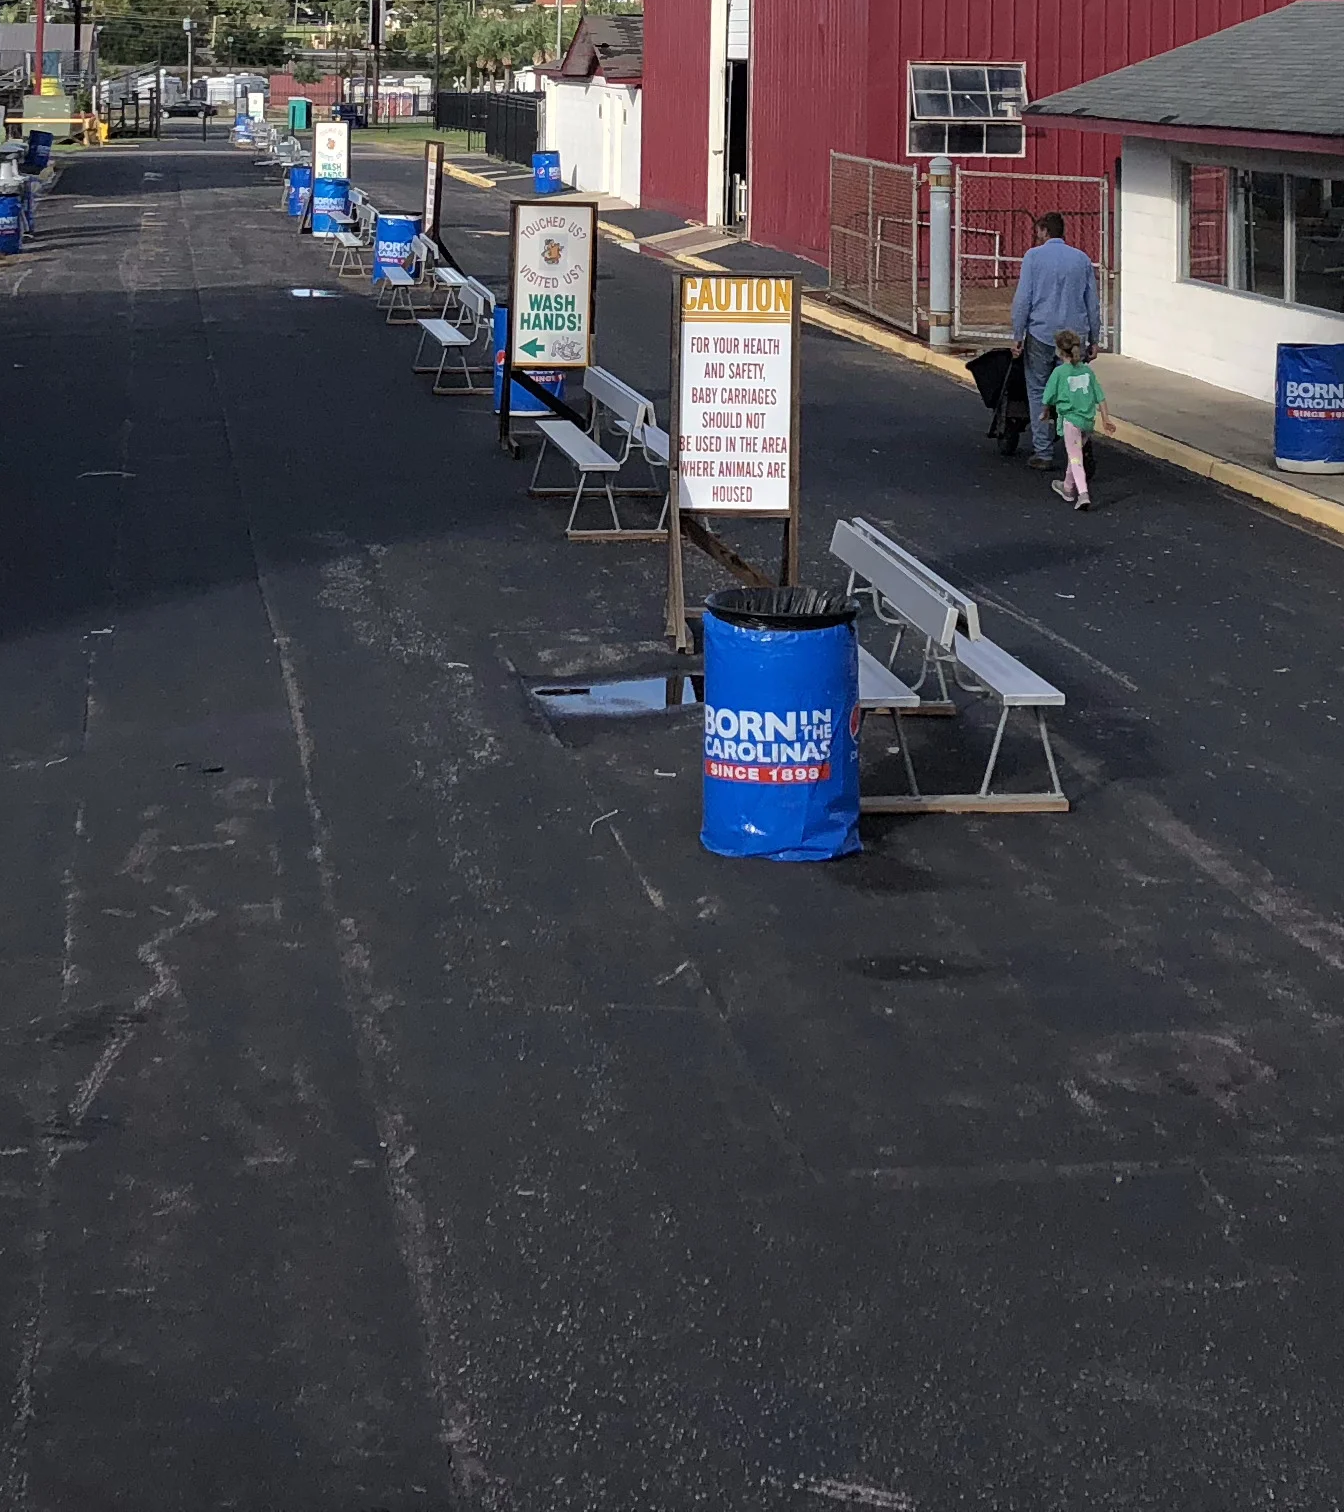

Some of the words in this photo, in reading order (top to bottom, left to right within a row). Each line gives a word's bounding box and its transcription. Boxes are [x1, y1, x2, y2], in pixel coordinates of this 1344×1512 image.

[521, 216, 566, 239] TOUCHED
[568, 222, 587, 240] US?
[520, 264, 559, 288] VISITED
[563, 264, 585, 285] US?
[528, 293, 576, 312] WASH
[682, 276, 791, 311] CAUTION
[520, 312, 582, 332] HANDS!
[690, 337, 709, 353] FOR
[713, 337, 739, 354] YOUR
[743, 338, 780, 355] HEALTH
[704, 362, 725, 379] AND
[728, 362, 766, 382] SAFETY,
[691, 387, 717, 404] BABY
[720, 387, 777, 405] CARRIAGES
[1286, 381, 1344, 399] BORN
[702, 411, 742, 429] SHOULD
[746, 412, 766, 429] NOT
[1292, 409, 1326, 418] SINCE
[679, 435, 692, 451] BE
[695, 435, 722, 452] USED
[725, 436, 736, 453] IN
[739, 436, 758, 453] THE
[761, 437, 787, 454] AREA
[679, 460, 715, 477] WHERE
[718, 461, 763, 478] ANIMALS
[766, 462, 786, 479] ARE
[712, 486, 753, 503] HOUSED
[705, 704, 797, 742] BORN
[799, 708, 832, 725] IN
[800, 723, 833, 740] THE
[705, 735, 832, 764] CAROLINAS
[710, 763, 760, 782] SINCE
[768, 766, 821, 782] 1898
